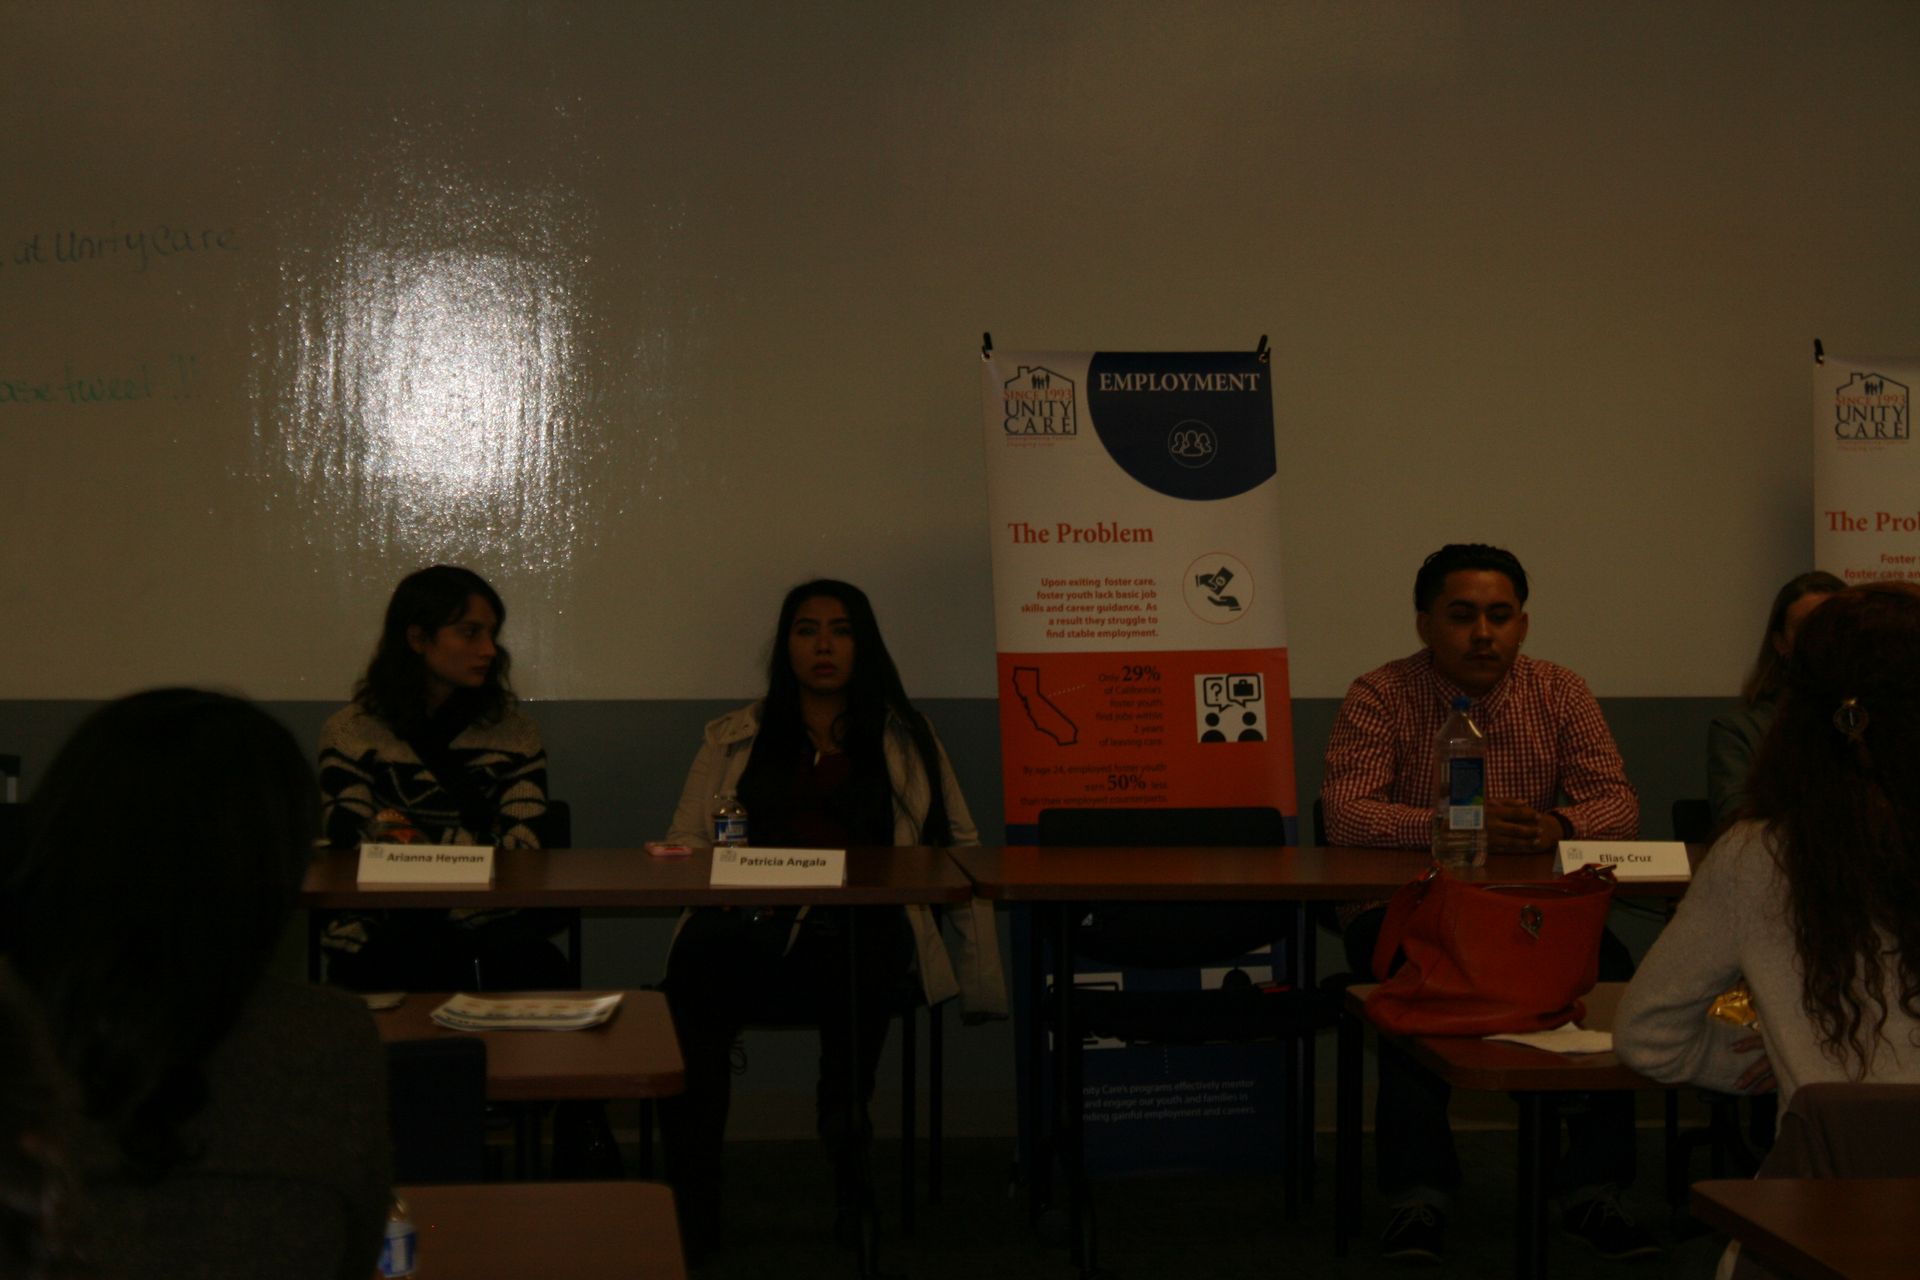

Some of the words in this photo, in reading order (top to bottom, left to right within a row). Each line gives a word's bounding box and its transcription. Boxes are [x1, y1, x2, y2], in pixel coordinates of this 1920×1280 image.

[14, 233, 46, 265] at
[1099, 373, 1260, 392] EMPLOYMENT
[1004, 390, 1039, 400] SINCE
[1005, 400, 1072, 417] UNITY
[1836, 406, 1905, 423] UNITY
[1004, 416, 1071, 434] CARE
[1835, 422, 1903, 438] CARE
[1825, 511, 1868, 532] The
[1008, 523, 1049, 544] The
[1057, 522, 1154, 544] Problem
[1881, 554, 1916, 564] Foster
[1845, 568, 1877, 579] foster
[1041, 578, 1066, 588] Upon
[1069, 578, 1101, 588] exiting
[1105, 578, 1132, 586] foster
[1037, 591, 1064, 600] foster
[1066, 590, 1093, 600] youth
[1095, 590, 1113, 599] lack
[1115, 590, 1139, 599] basic
[1141, 590, 1157, 600] job
[1021, 603, 1044, 613] skills
[1046, 603, 1063, 612] and
[1066, 604, 1095, 612] career
[1097, 603, 1142, 614] guidance.
[1146, 603, 1157, 612] As
[1056, 616, 1083, 625] result
[1085, 616, 1105, 627] they
[1107, 616, 1146, 627] struggle
[1046, 629, 1065, 638] find
[1067, 629, 1095, 638] stable
[1097, 628, 1159, 639] employment.
[1122, 666, 1160, 682] 29%
[1107, 774, 1146, 790] 50%
[387, 853, 432, 862] Arianna
[436, 854, 484, 864] Heyman
[740, 857, 783, 866] Patricia
[787, 858, 826, 868] Angala
[1599, 854, 1626, 863] Elias
[1628, 854, 1652, 863] Cruz
[1083, 1085, 1100, 1096] nity
[1174, 1081, 1220, 1090] effectively
[1156, 1096, 1182, 1107] youth
[1184, 1095, 1201, 1104] and
[1111, 1111, 1143, 1122] gainful
[1144, 1107, 1201, 1120] employment
